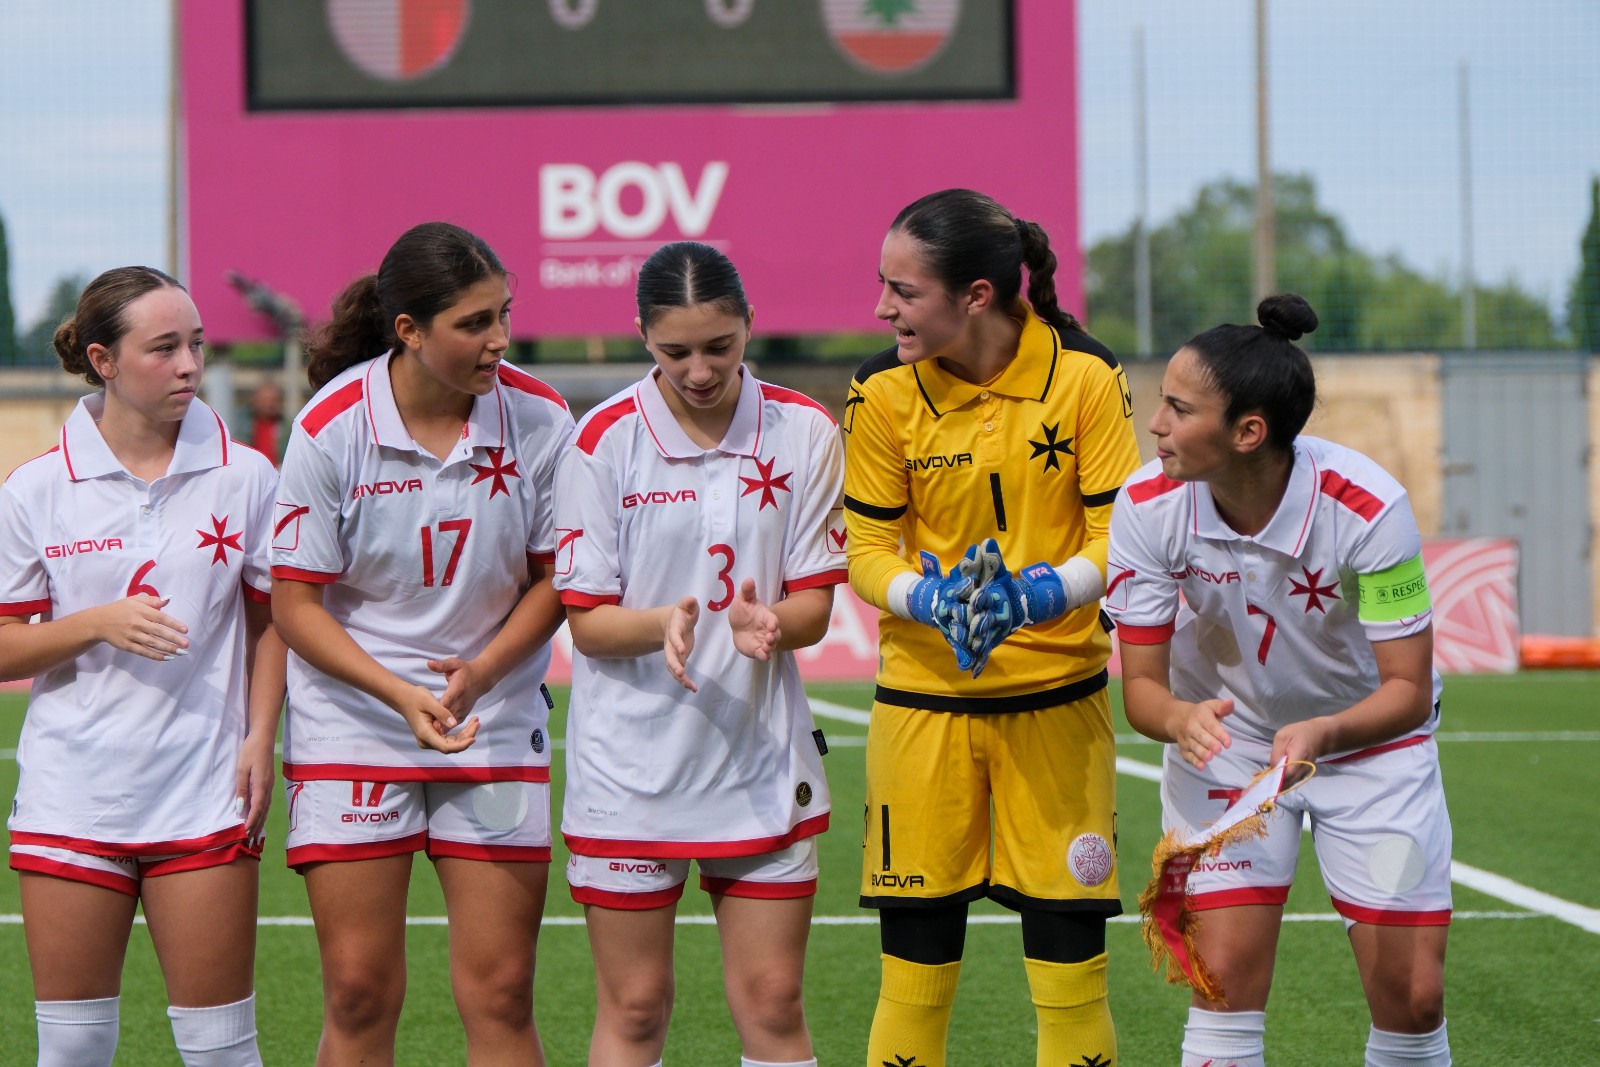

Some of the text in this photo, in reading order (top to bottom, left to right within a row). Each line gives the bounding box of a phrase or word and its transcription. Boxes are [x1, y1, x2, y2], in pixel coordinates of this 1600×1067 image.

[539, 160, 730, 240] BOV
[539, 257, 599, 288] Bank
[601, 255, 632, 287] of
[904, 452, 972, 471] GIVOVA
[622, 489, 697, 508] GVOVA
[989, 473, 1007, 532] 1
[45, 538, 123, 559] GIVOVA
[420, 518, 473, 588] 17
[707, 543, 736, 612] 3
[1246, 603, 1277, 667] 7
[341, 810, 399, 823] GIVOVA
[881, 804, 891, 872] 1
[608, 861, 667, 874] GIVOVA
[1191, 860, 1252, 873] GIVOVA
[871, 873, 925, 888] VOVA
